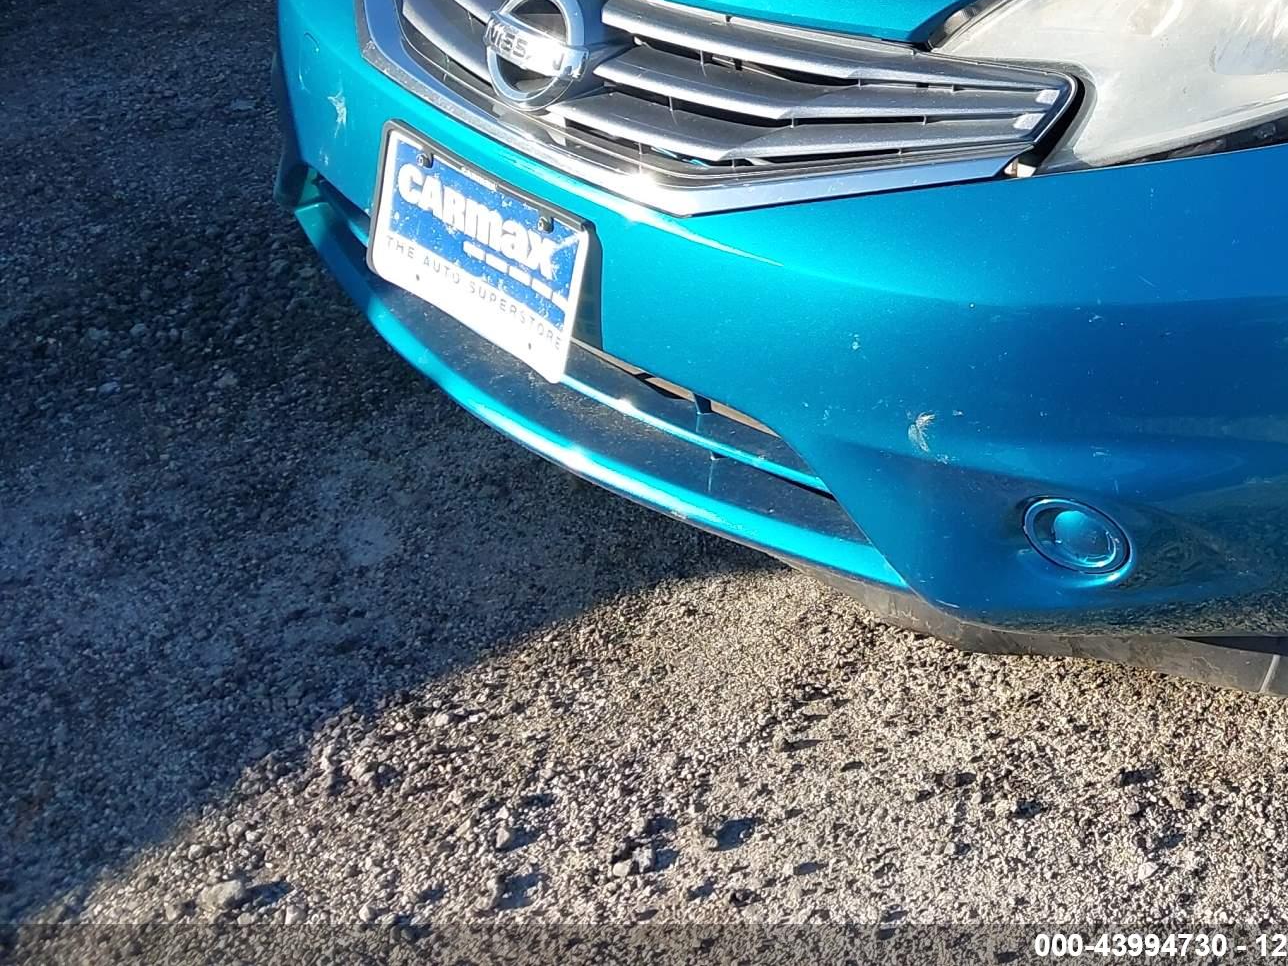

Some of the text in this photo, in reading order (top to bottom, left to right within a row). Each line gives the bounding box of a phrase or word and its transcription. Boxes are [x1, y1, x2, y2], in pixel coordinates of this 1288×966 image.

[487, 14, 566, 72] NISSN
[385, 235, 563, 351] THE AUTO SUPERSTORE
